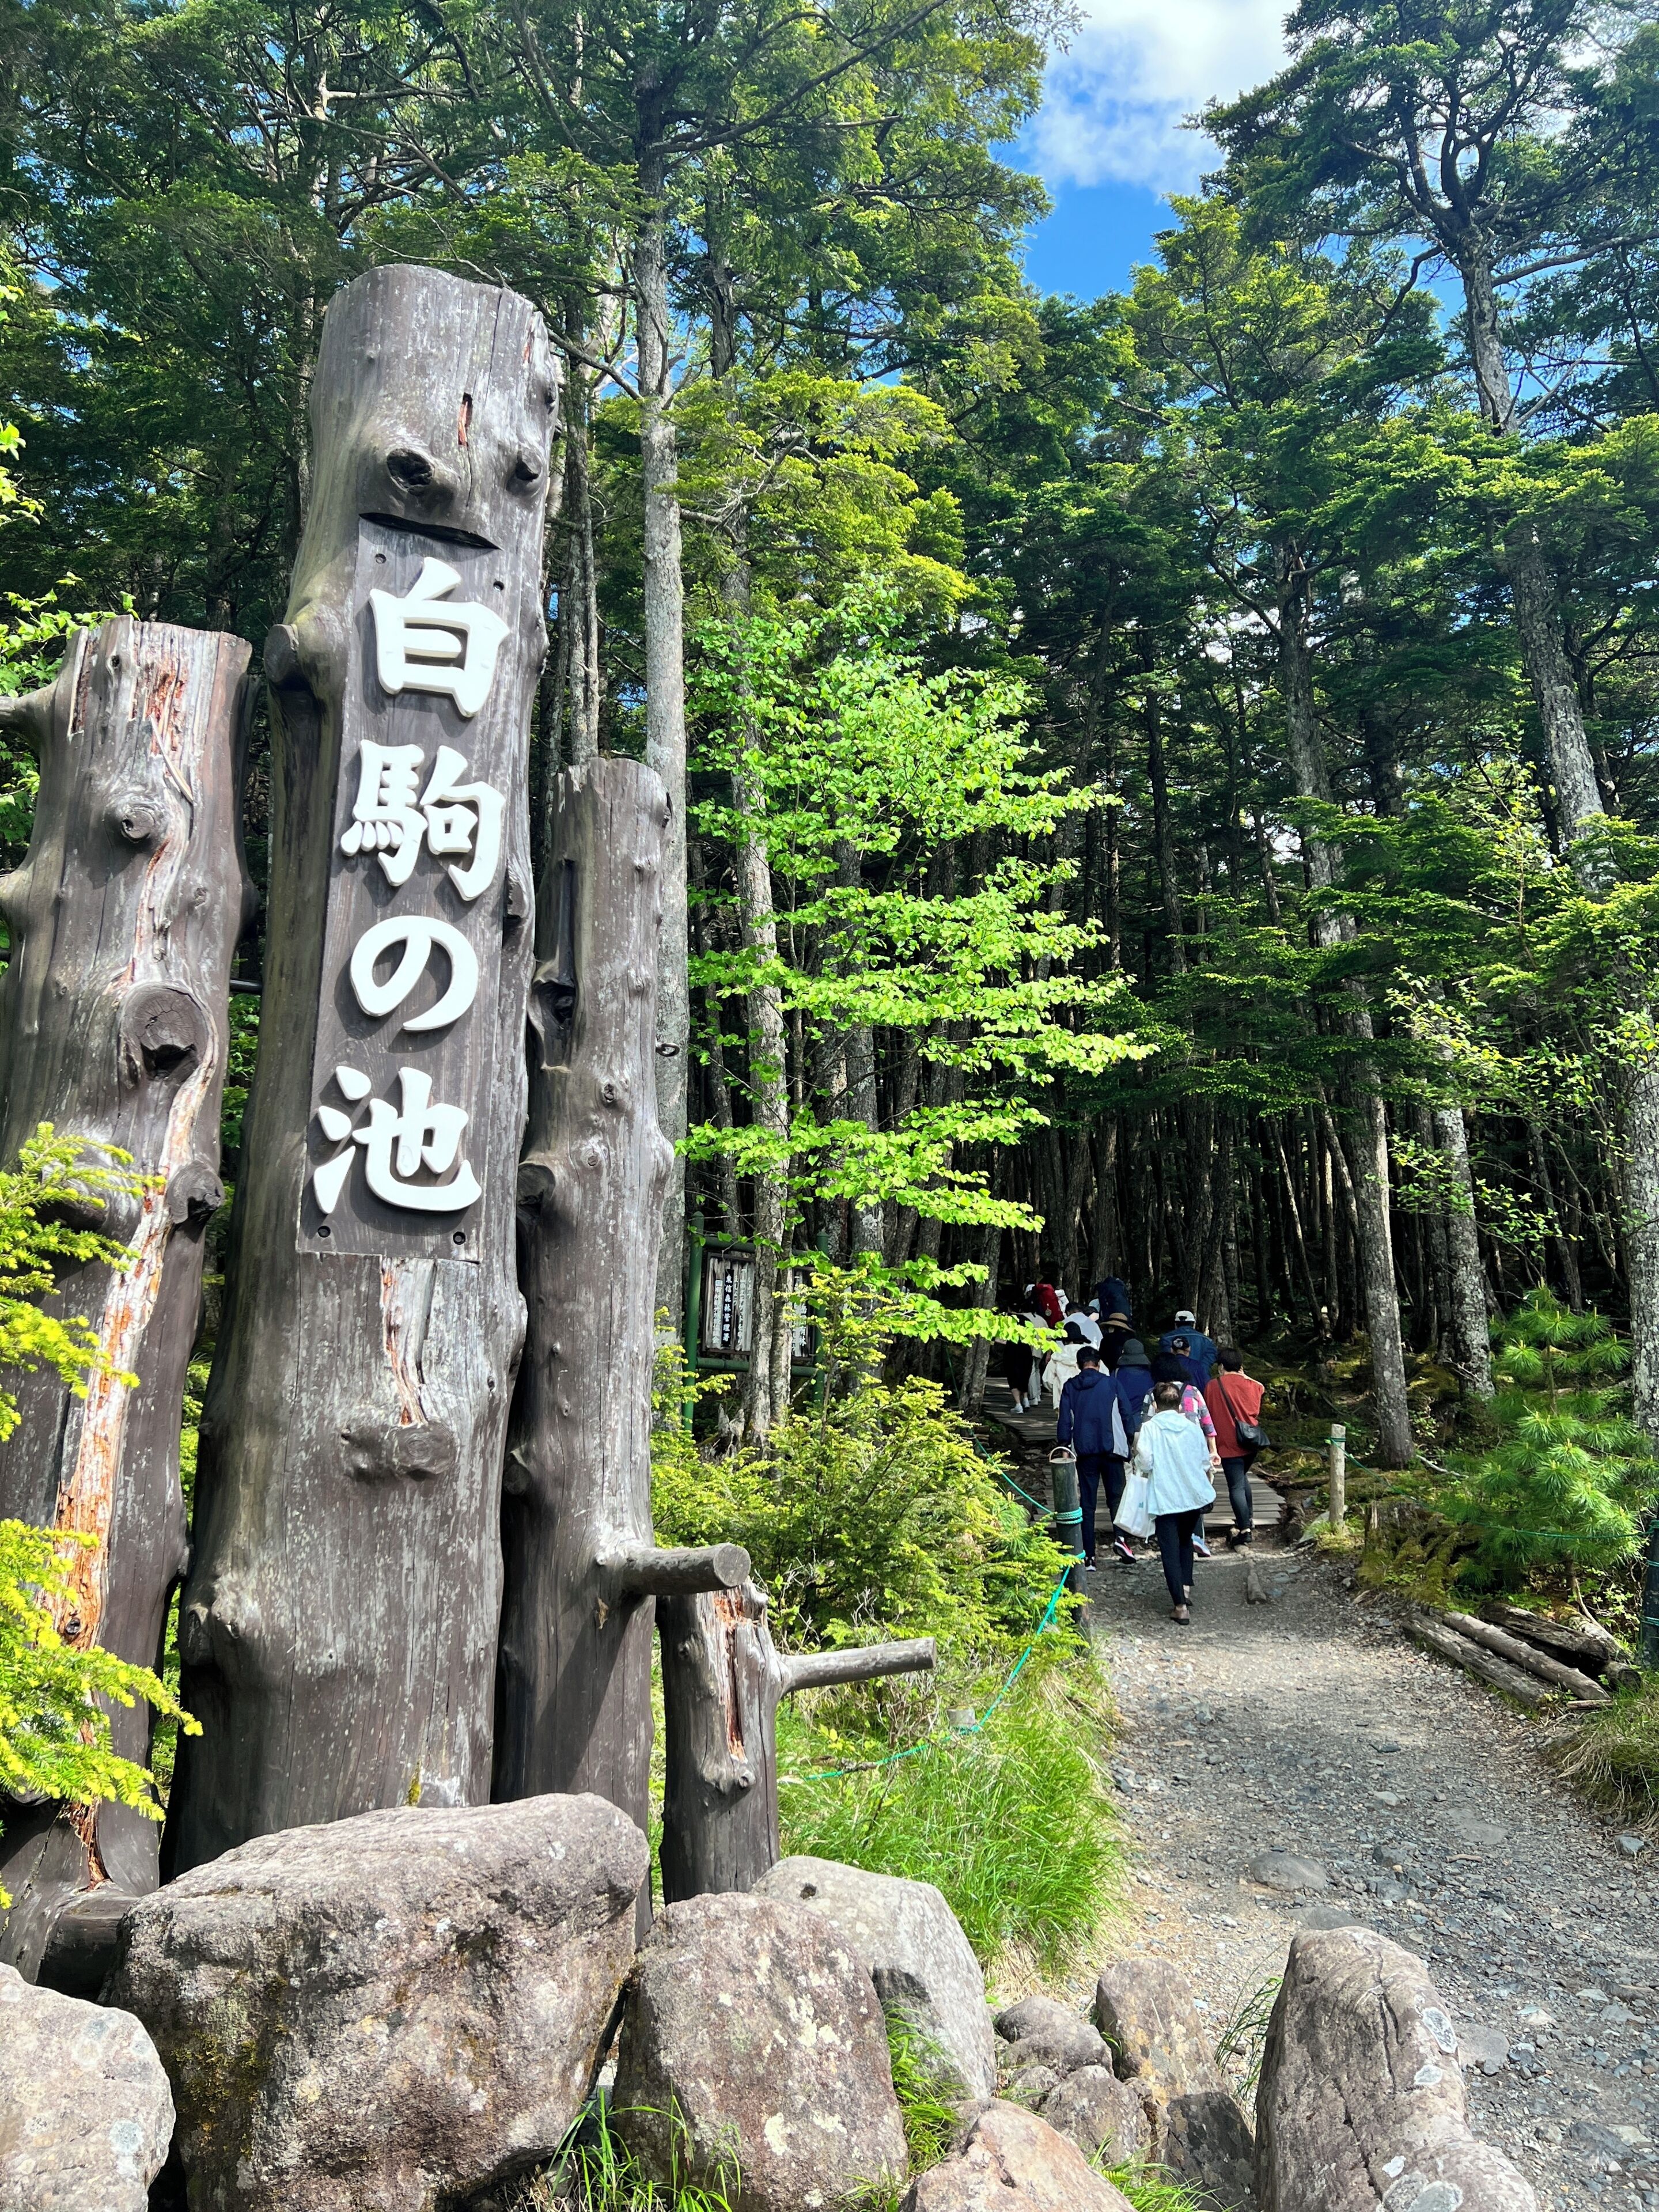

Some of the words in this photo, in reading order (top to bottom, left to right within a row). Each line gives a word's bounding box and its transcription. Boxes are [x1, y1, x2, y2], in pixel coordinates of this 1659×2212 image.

[314, 557, 510, 1214] 白駒の池
[722, 1274, 733, 1342] 東信森林管理署
